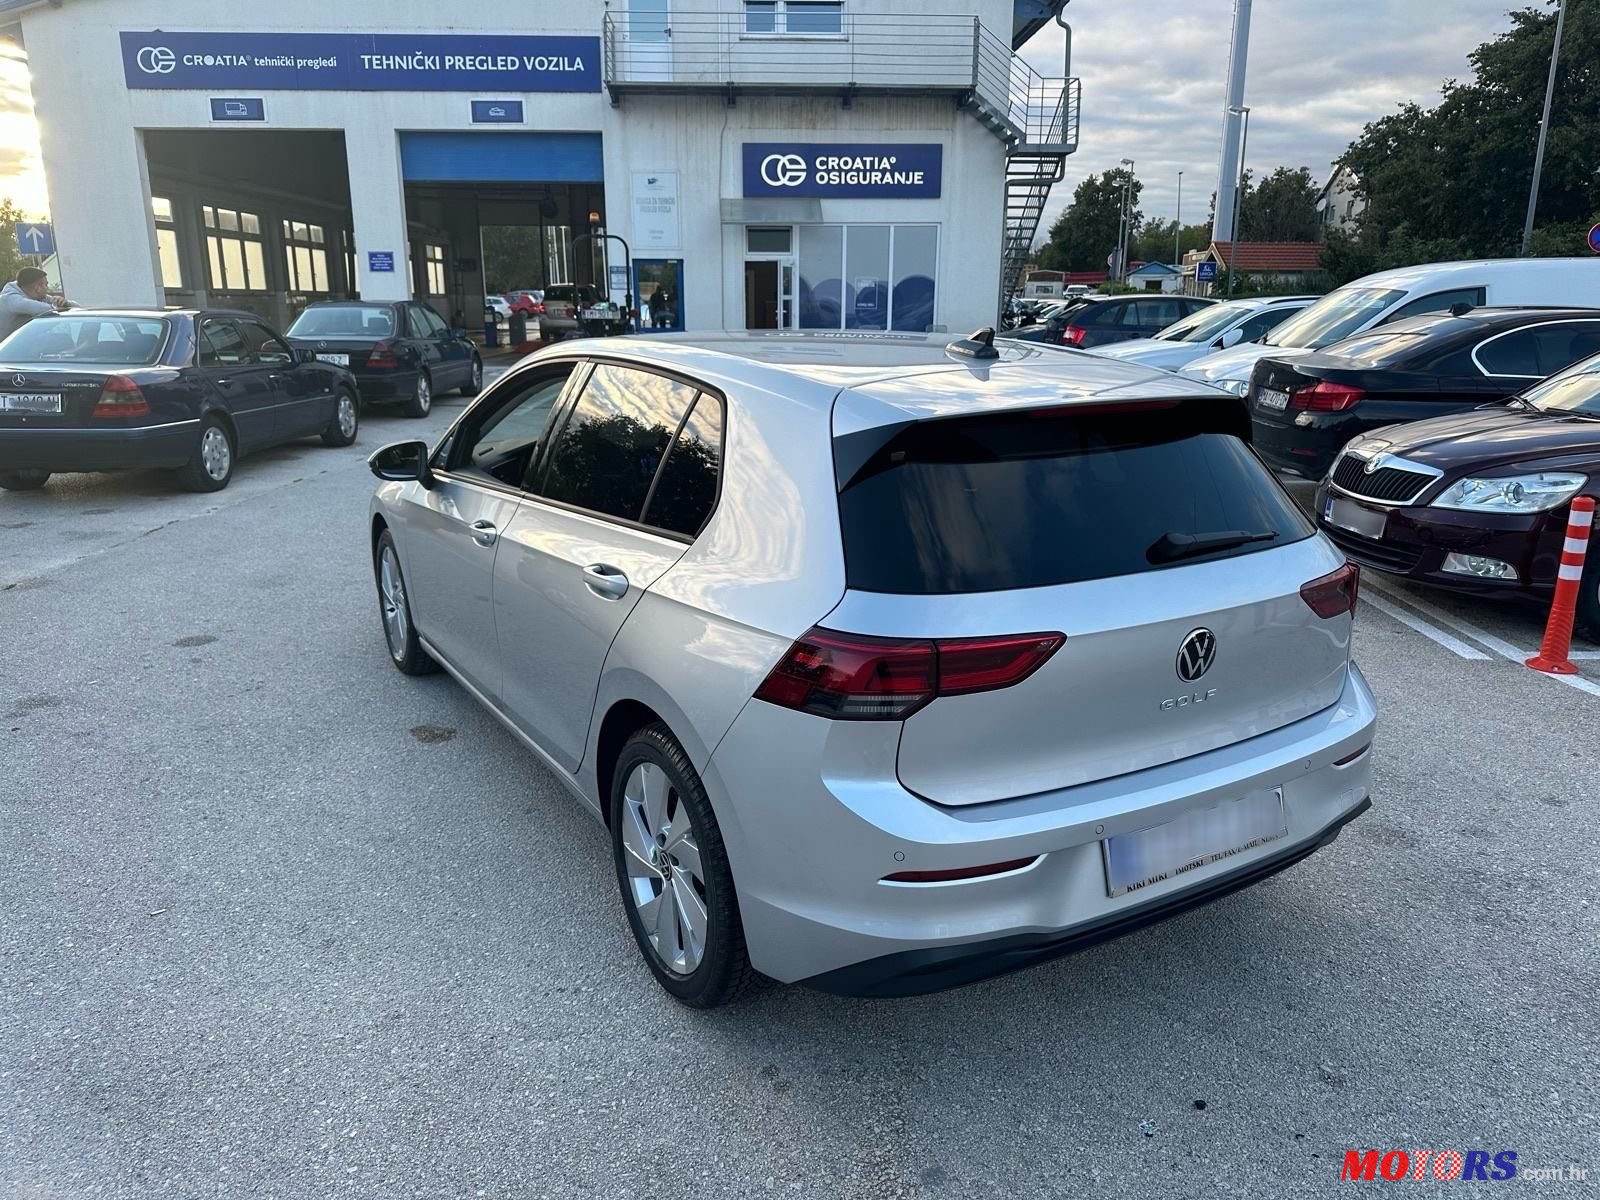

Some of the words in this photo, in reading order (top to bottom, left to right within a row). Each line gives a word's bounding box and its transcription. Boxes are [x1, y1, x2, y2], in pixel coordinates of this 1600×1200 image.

[254, 55, 294, 67] tehnički
[297, 56, 337, 69] pregledi
[360, 51, 440, 70] TEHNIČKI
[445, 55, 519, 71] PREGLED
[523, 56, 585, 71] VOZILA
[815, 171, 924, 185] OSIGURANJE
[1159, 688, 1217, 710] GOLF
[1126, 880, 1146, 893] KIKI
[1147, 871, 1168, 885] MIKI
[1175, 859, 1204, 875] IMOTSKI
